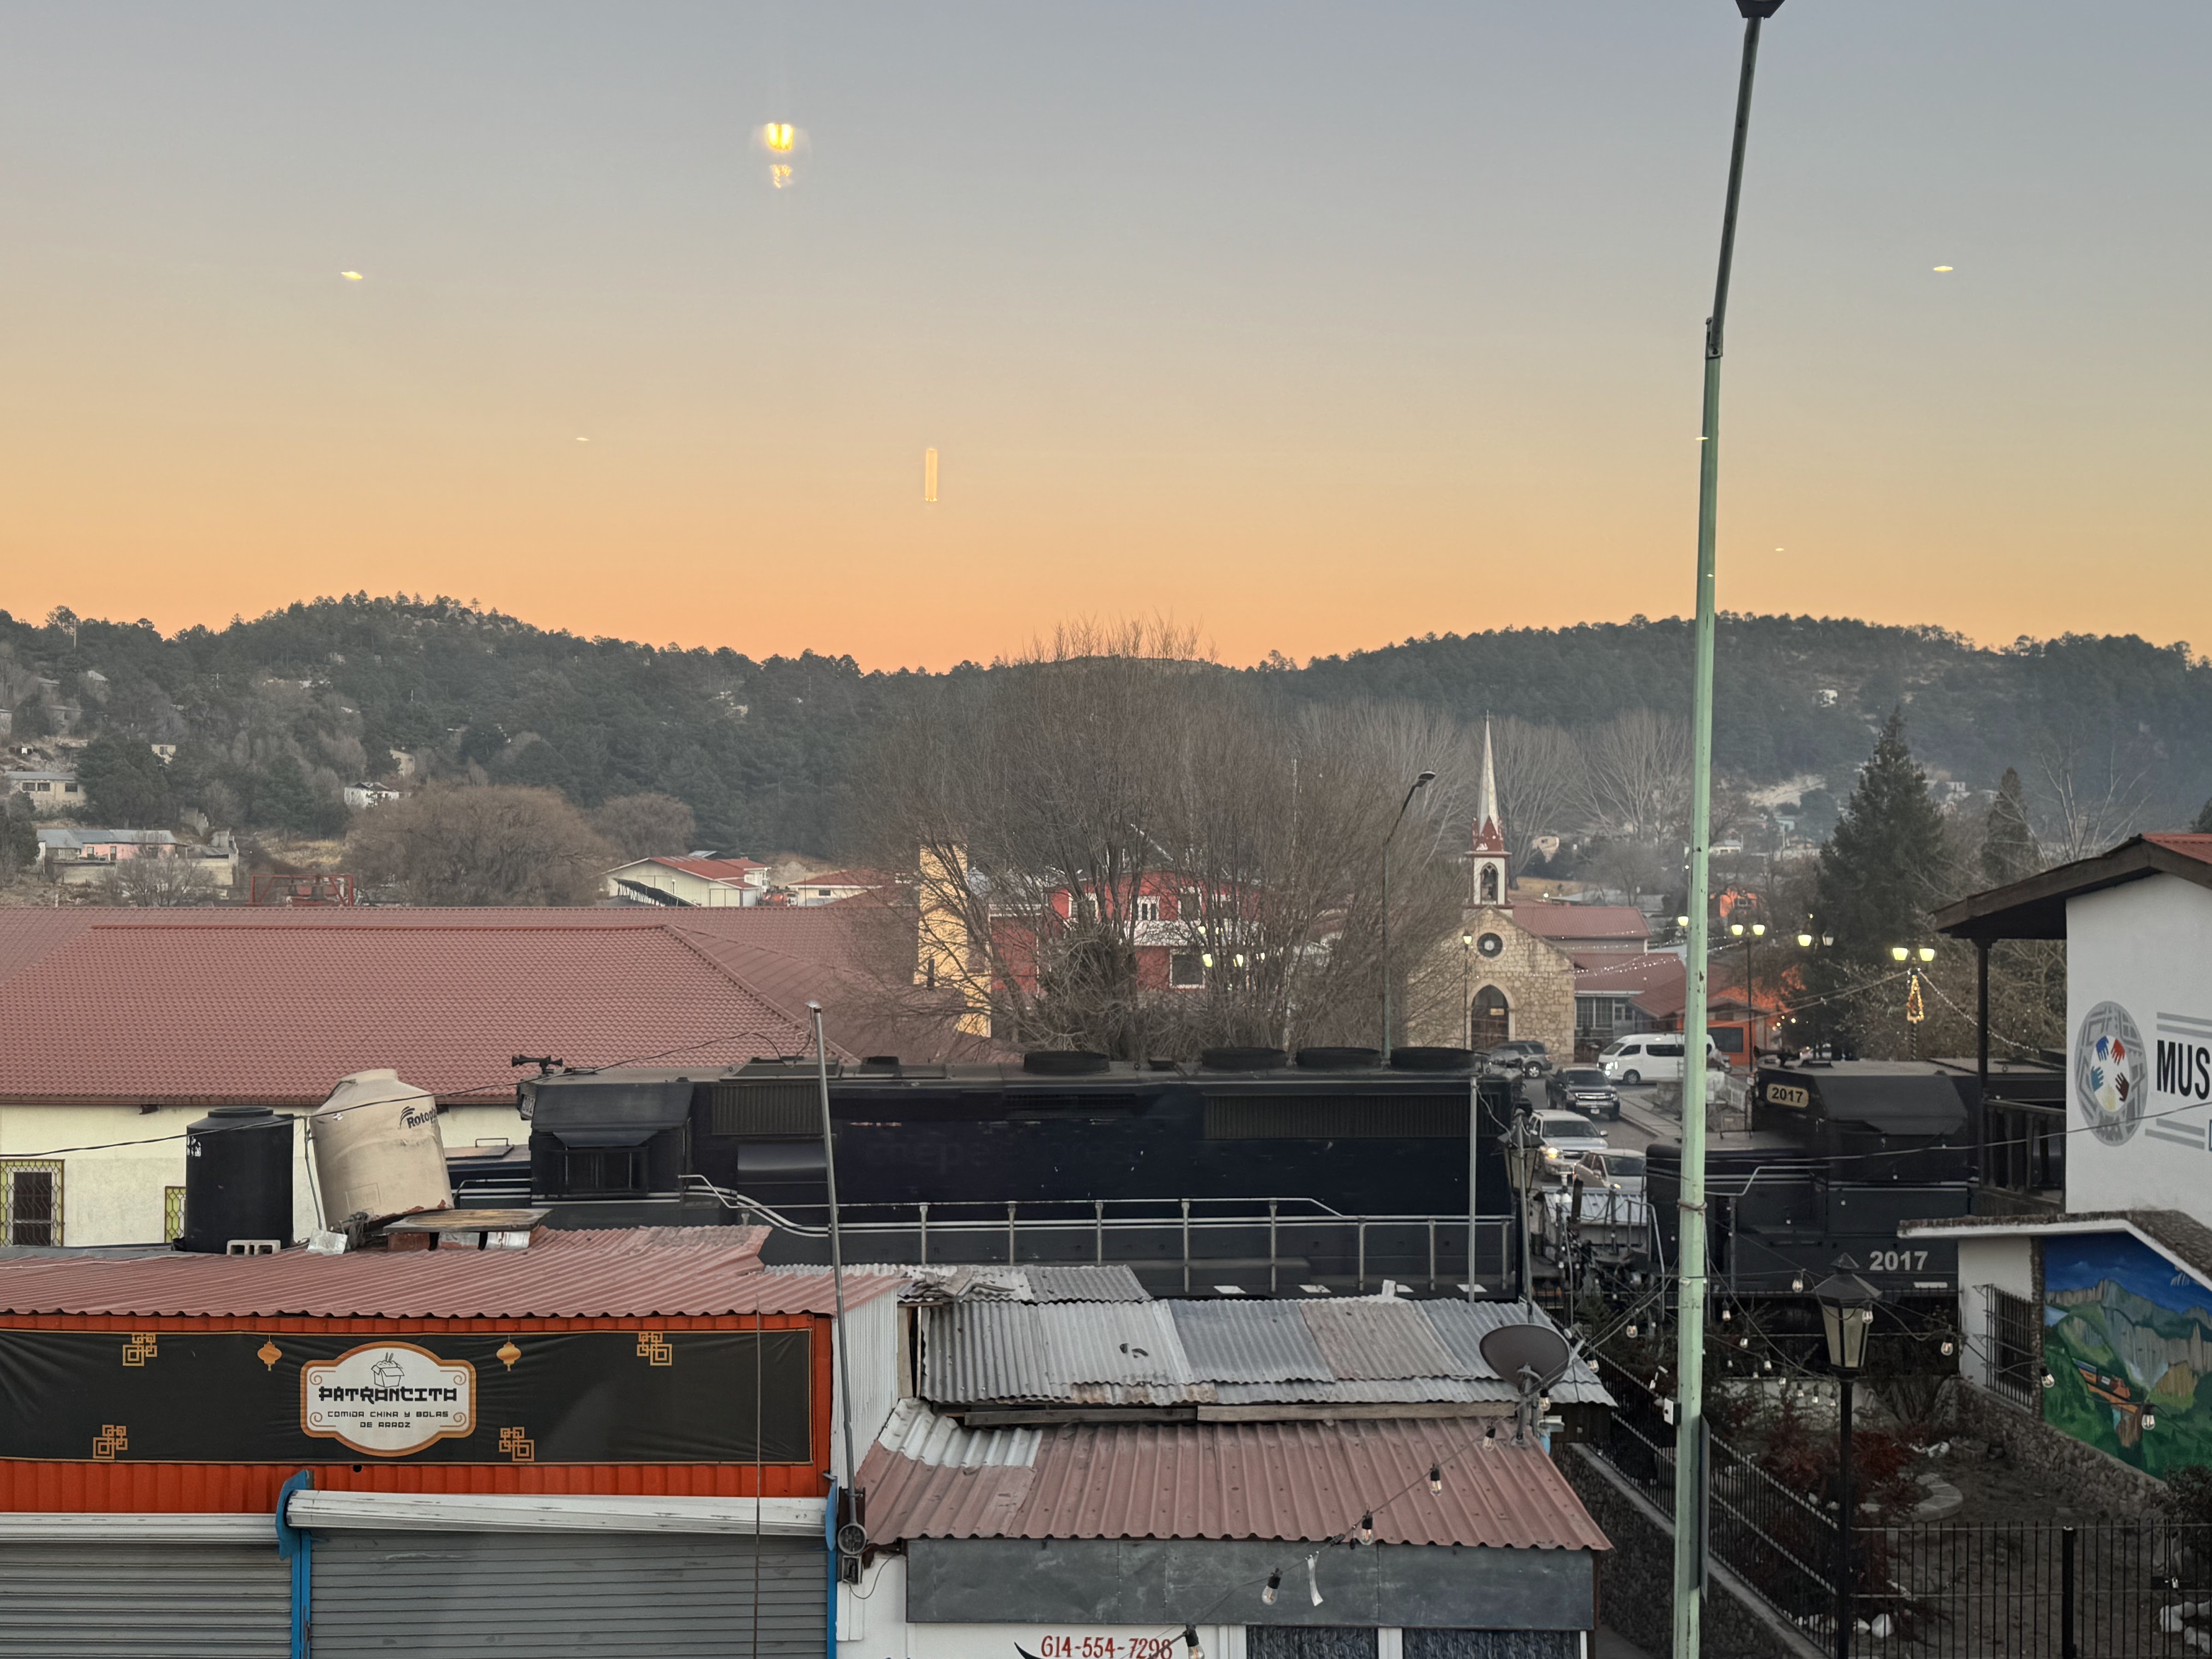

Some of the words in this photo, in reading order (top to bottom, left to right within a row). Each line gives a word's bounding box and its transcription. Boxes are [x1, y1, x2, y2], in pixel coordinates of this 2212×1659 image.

[1772, 1087, 1803, 1103] 2017
[1869, 1250, 1928, 1271] 2017
[318, 1386, 458, 1405] PATRONCITO
[1041, 1635, 1172, 1659] 614-554-7298
